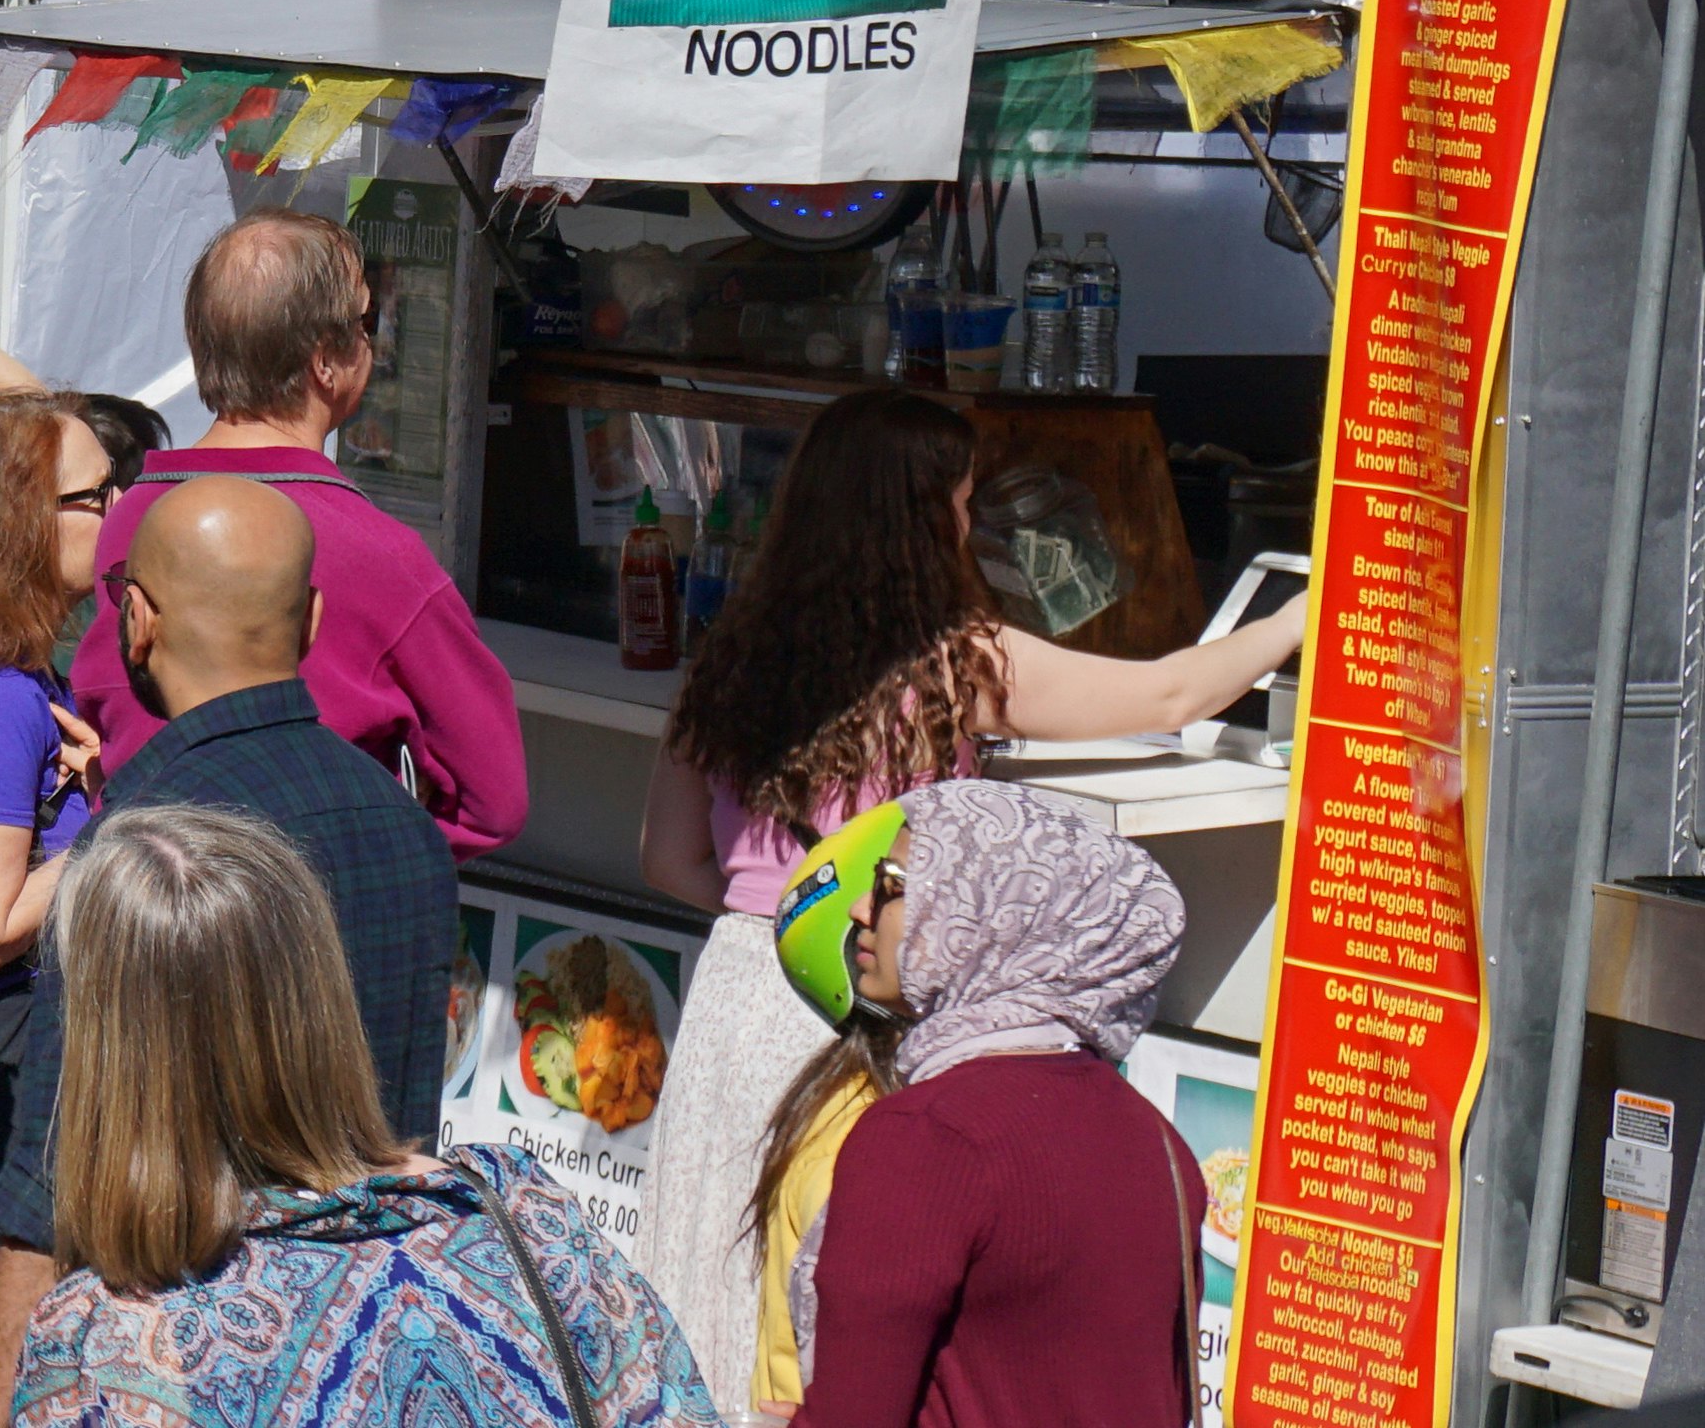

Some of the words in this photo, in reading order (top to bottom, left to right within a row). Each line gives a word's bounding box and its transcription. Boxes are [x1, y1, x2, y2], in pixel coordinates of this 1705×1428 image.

[685, 21, 917, 77] NOODLES
[411, 221, 452, 261] ARTIST
[1345, 939, 1392, 965] sauce.
[1396, 943, 1438, 974] Yikes!
[1325, 978, 1368, 1007] Go-Gi
[1372, 987, 1444, 1024] Vegetarian
[1335, 1012, 1354, 1030] or
[1355, 1013, 1406, 1046] chicken
[1408, 1023, 1427, 1048] $6
[1337, 1042, 1381, 1073] Nepali
[1383, 1052, 1410, 1081] style
[508, 1127, 590, 1178] Chicken
[587, 1195, 638, 1236] $8.00
[1298, 1176, 1328, 1199] you
[1331, 1179, 1368, 1209] when
[1370, 1190, 1394, 1215] you
[1396, 1201, 1413, 1222] go
[1266, 1275, 1291, 1299] low
[1294, 1281, 1313, 1306] fat
[1315, 1289, 1363, 1322] quickly
[1366, 1303, 1387, 1324] stir
[1388, 1312, 1406, 1334] fry
